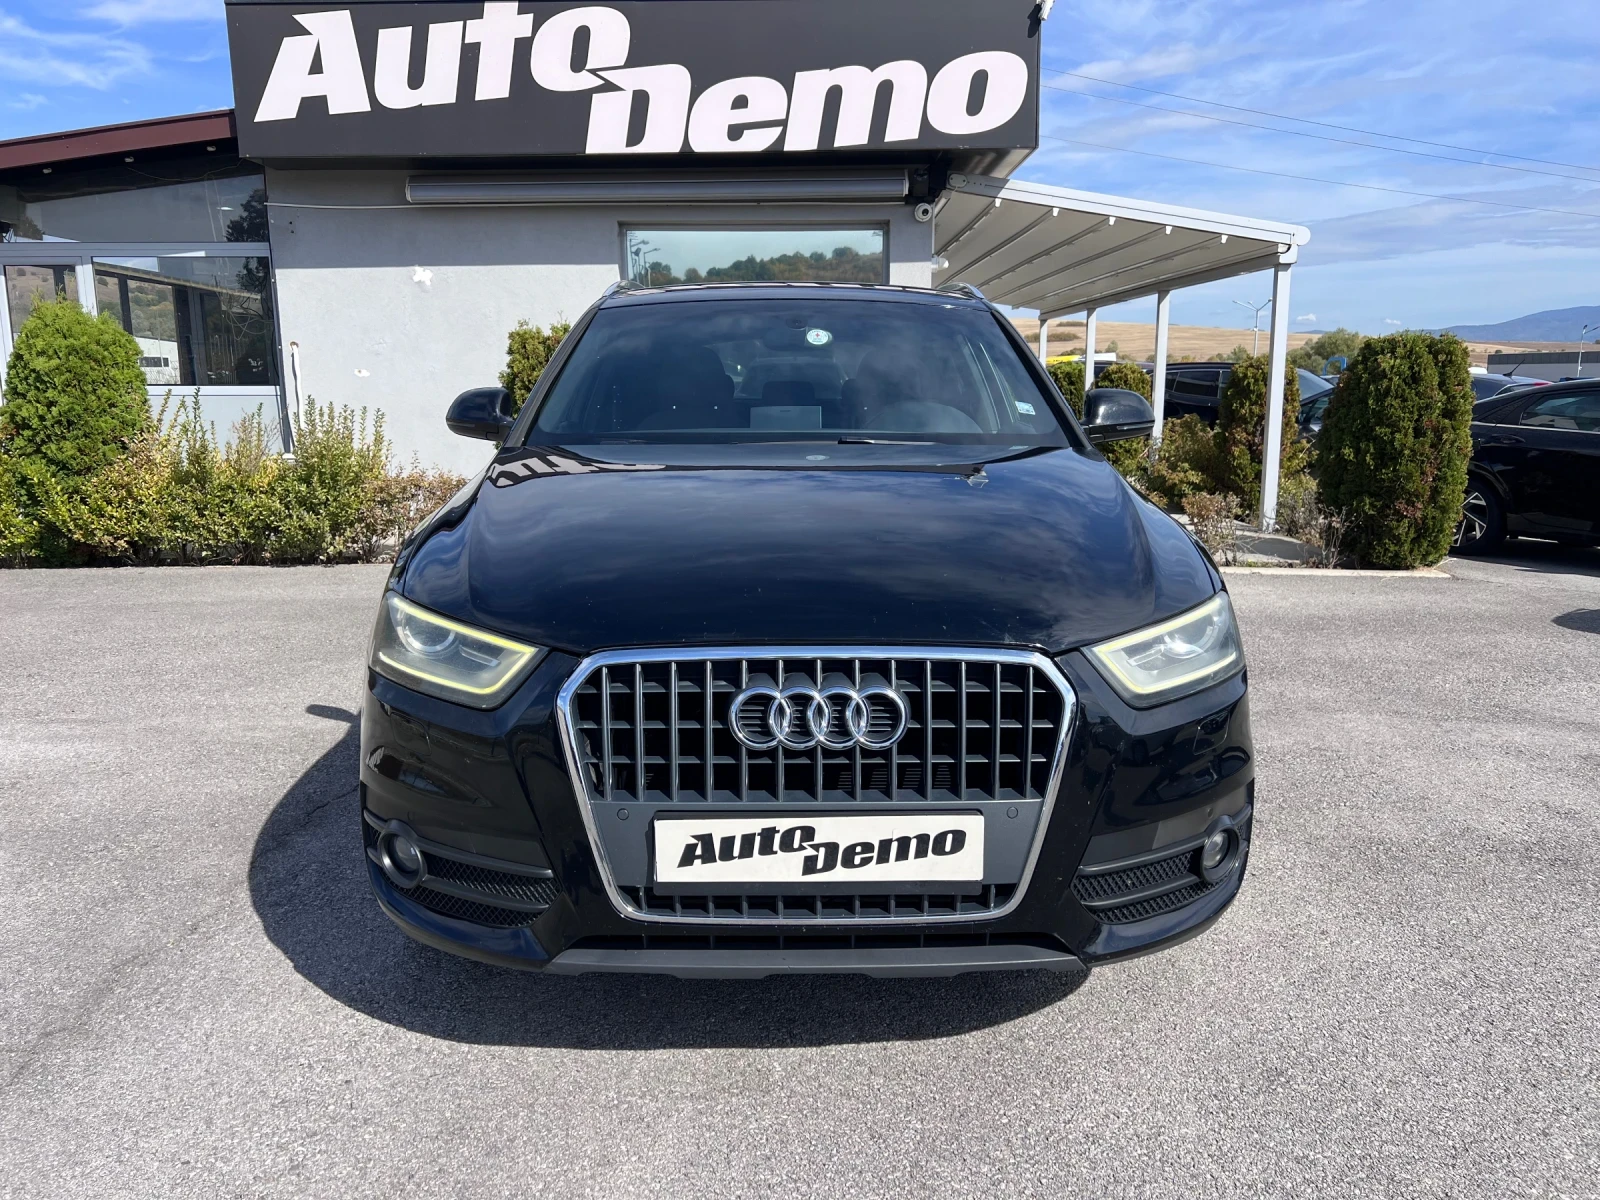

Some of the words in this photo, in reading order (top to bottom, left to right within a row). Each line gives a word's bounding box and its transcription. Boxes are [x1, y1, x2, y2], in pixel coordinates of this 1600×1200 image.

[254, 1, 630, 122] Auto
[585, 50, 1028, 154] Demo
[677, 825, 815, 868] Auto
[801, 829, 966, 876] Demo
